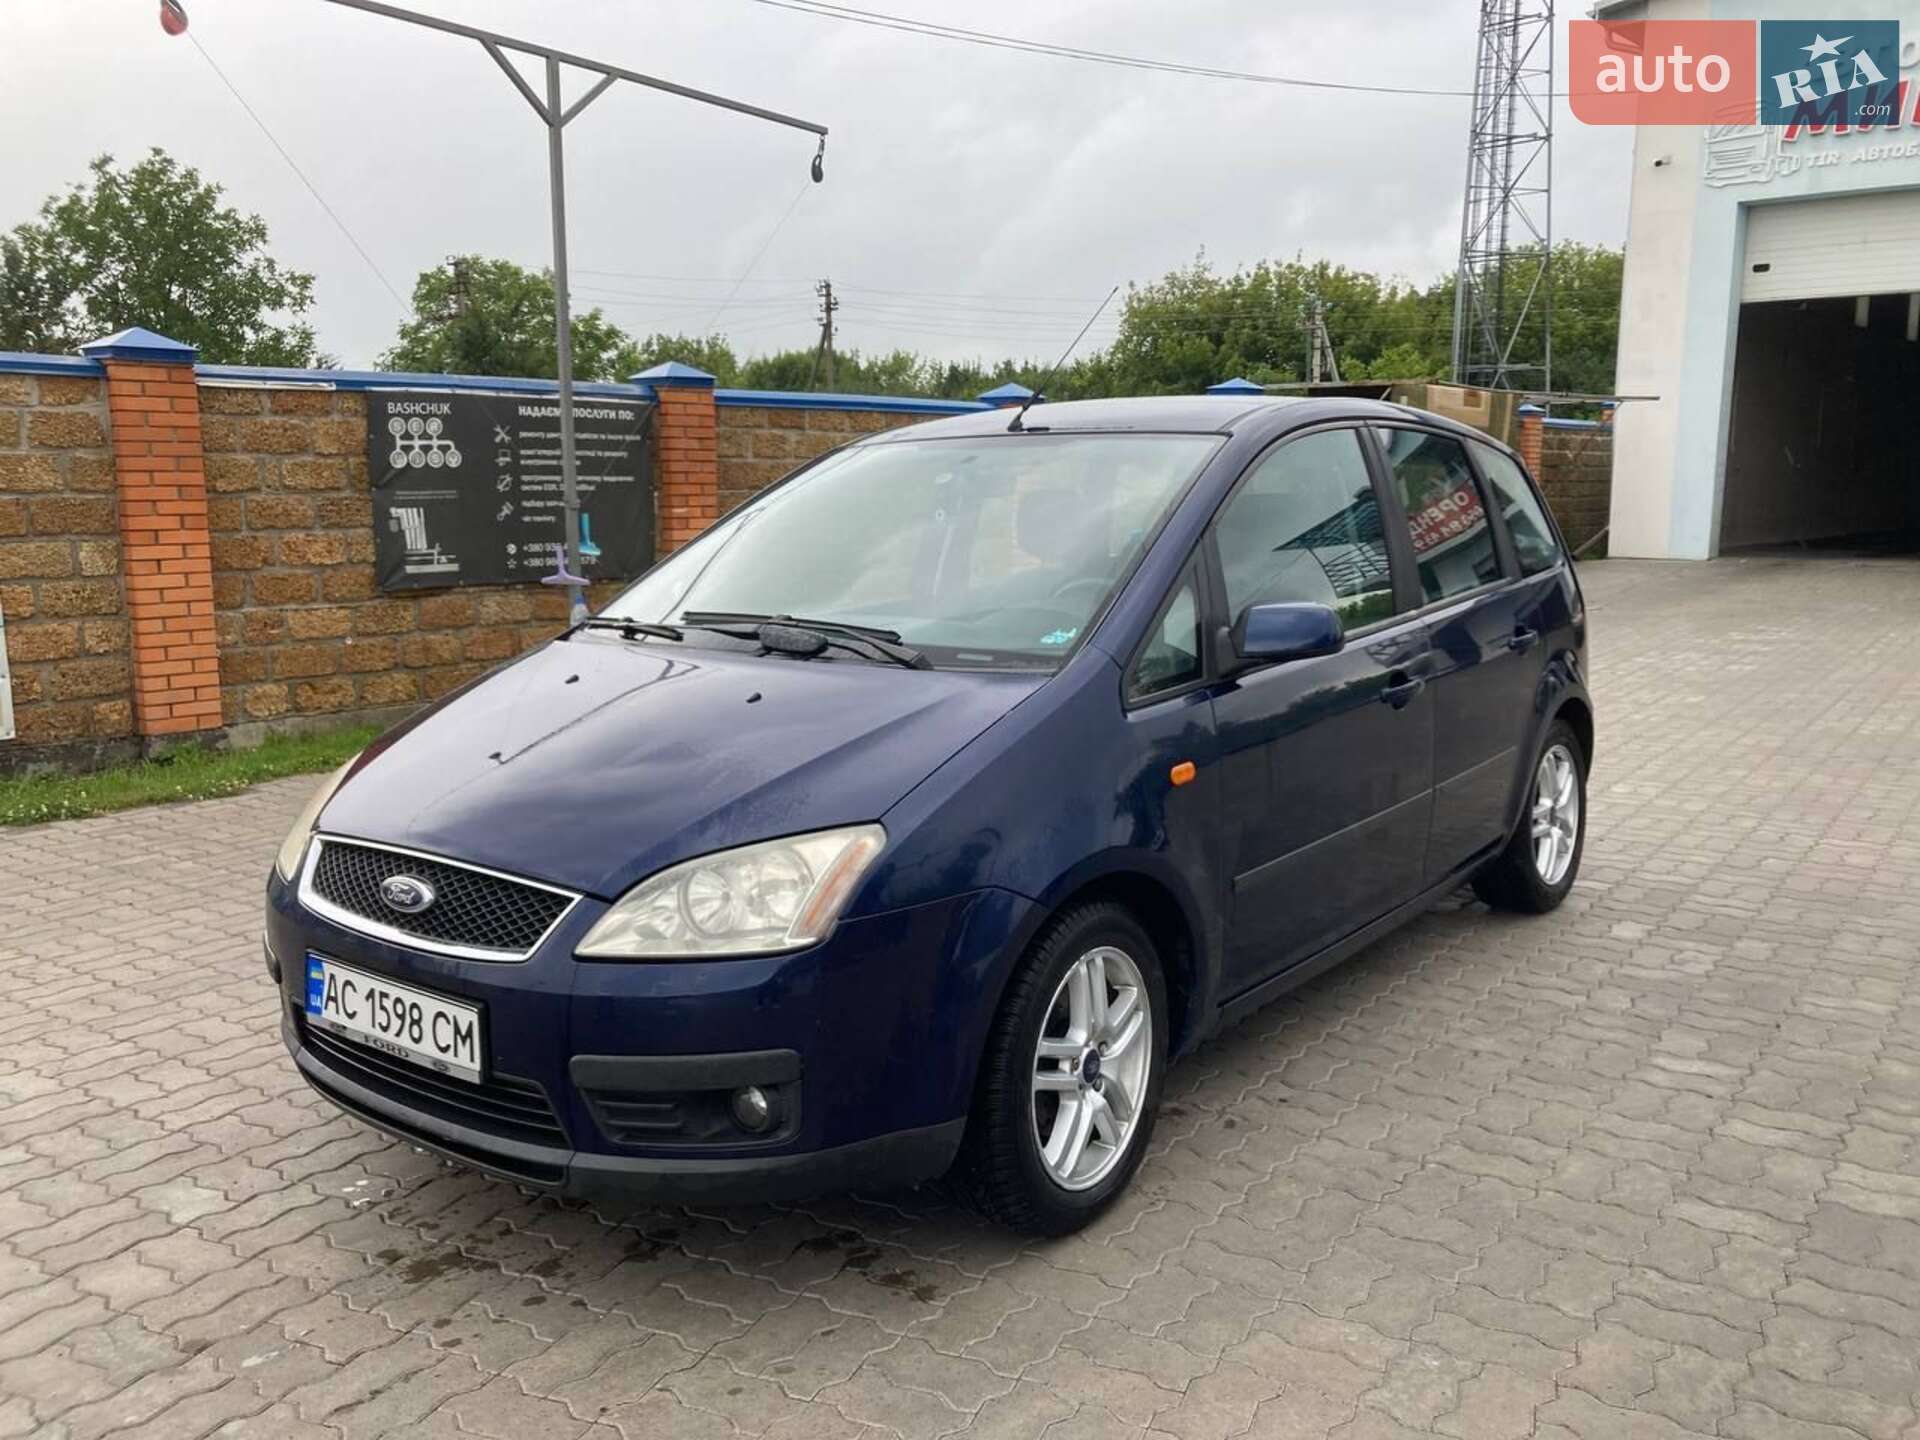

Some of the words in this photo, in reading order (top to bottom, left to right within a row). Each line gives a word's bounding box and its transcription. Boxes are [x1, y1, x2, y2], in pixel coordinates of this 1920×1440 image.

[1850, 142, 1920, 165] АВТОБ
[387, 402, 452, 415] BASHCHUK
[518, 405, 562, 418] НАДАЄМ
[572, 407, 617, 420] ПОСЛУГИ
[324, 972, 358, 1020] AC
[365, 987, 423, 1044] 1598
[432, 1011, 475, 1063] CM
